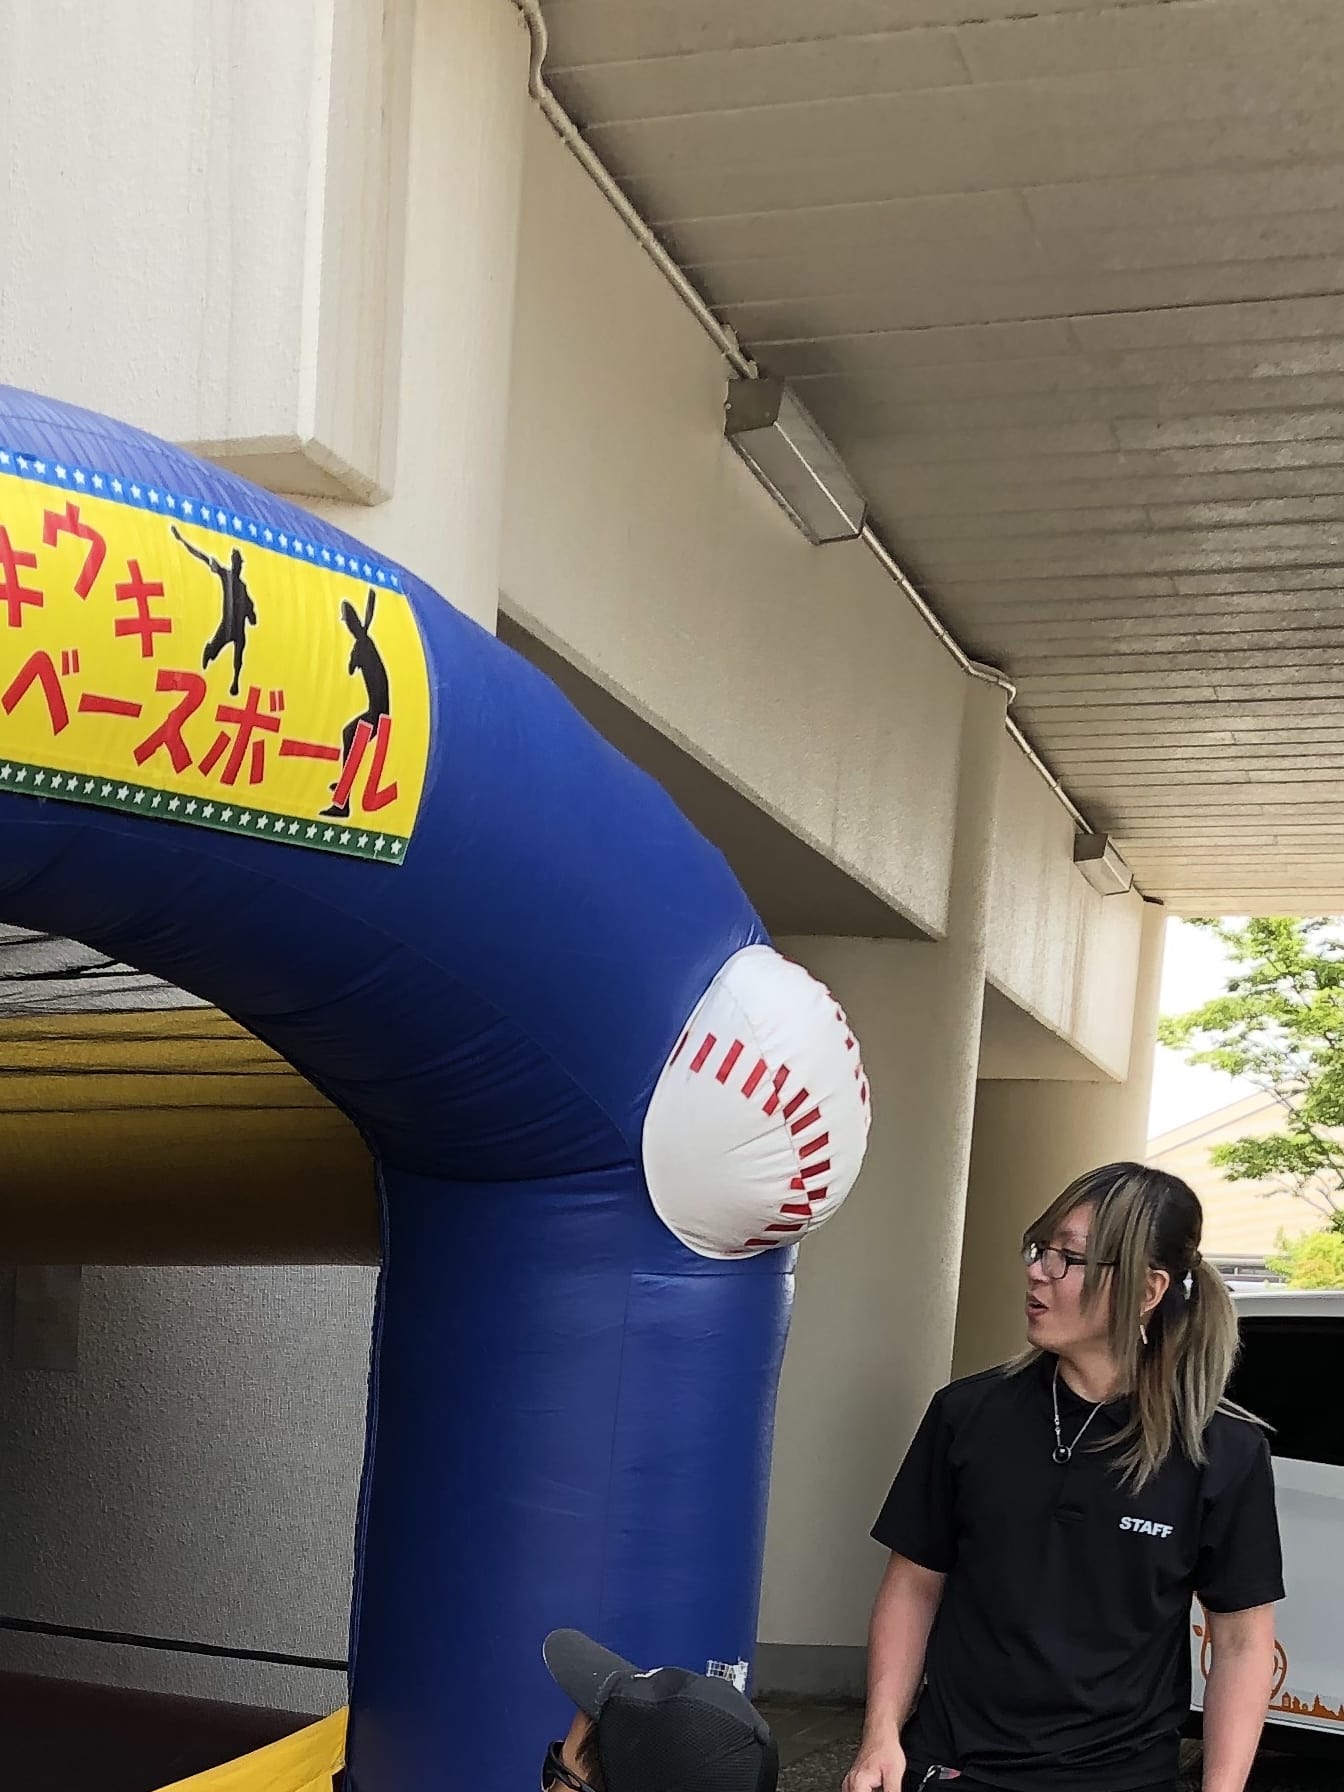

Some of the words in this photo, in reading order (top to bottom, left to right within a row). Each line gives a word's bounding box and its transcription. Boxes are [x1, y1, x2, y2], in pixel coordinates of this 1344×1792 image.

[1, 648, 398, 812] ベースボール
[1118, 1516, 1174, 1539] STAFF
